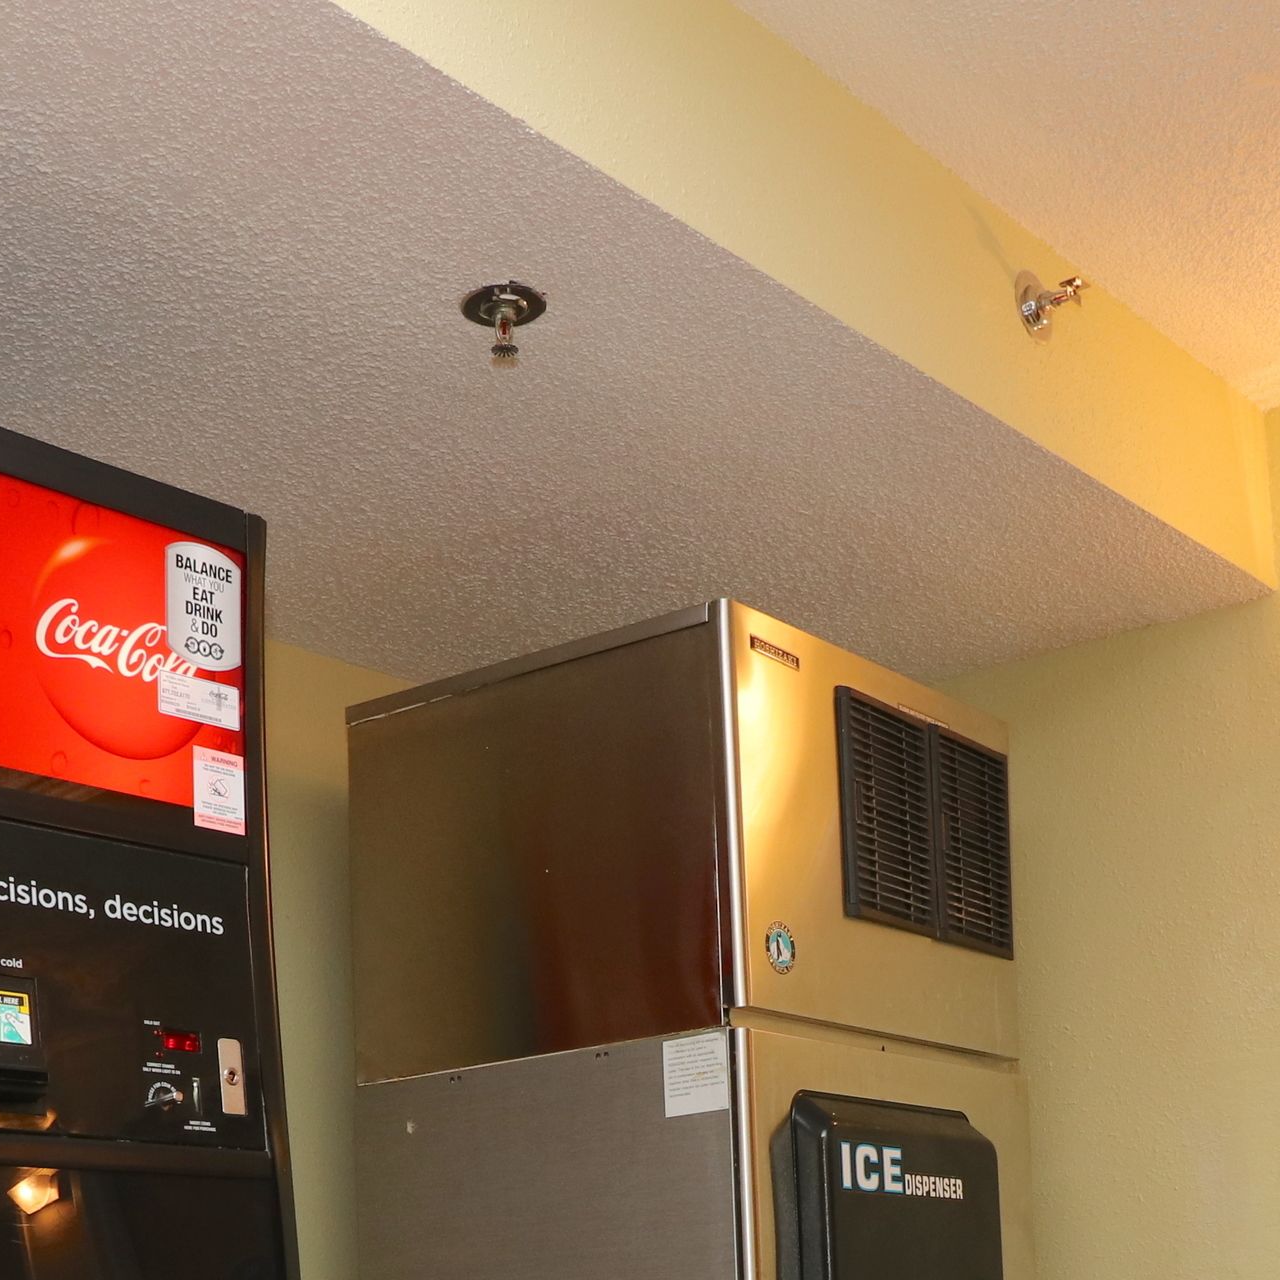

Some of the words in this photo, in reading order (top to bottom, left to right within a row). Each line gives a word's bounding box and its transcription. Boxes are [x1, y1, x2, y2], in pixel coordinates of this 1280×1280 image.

[175, 553, 232, 583] BALANCE
[184, 573, 207, 588] WHAT
[208, 580, 225, 593] YOU
[193, 587, 215, 605] EAT
[185, 601, 223, 624] DRINK
[191, 618, 199, 633] &
[201, 621, 218, 638] DO
[104, 894, 225, 936] decisions
[0, 958, 23, 969] cold
[840, 1141, 904, 1193] ICE
[904, 1173, 964, 1199] DISPENSER
